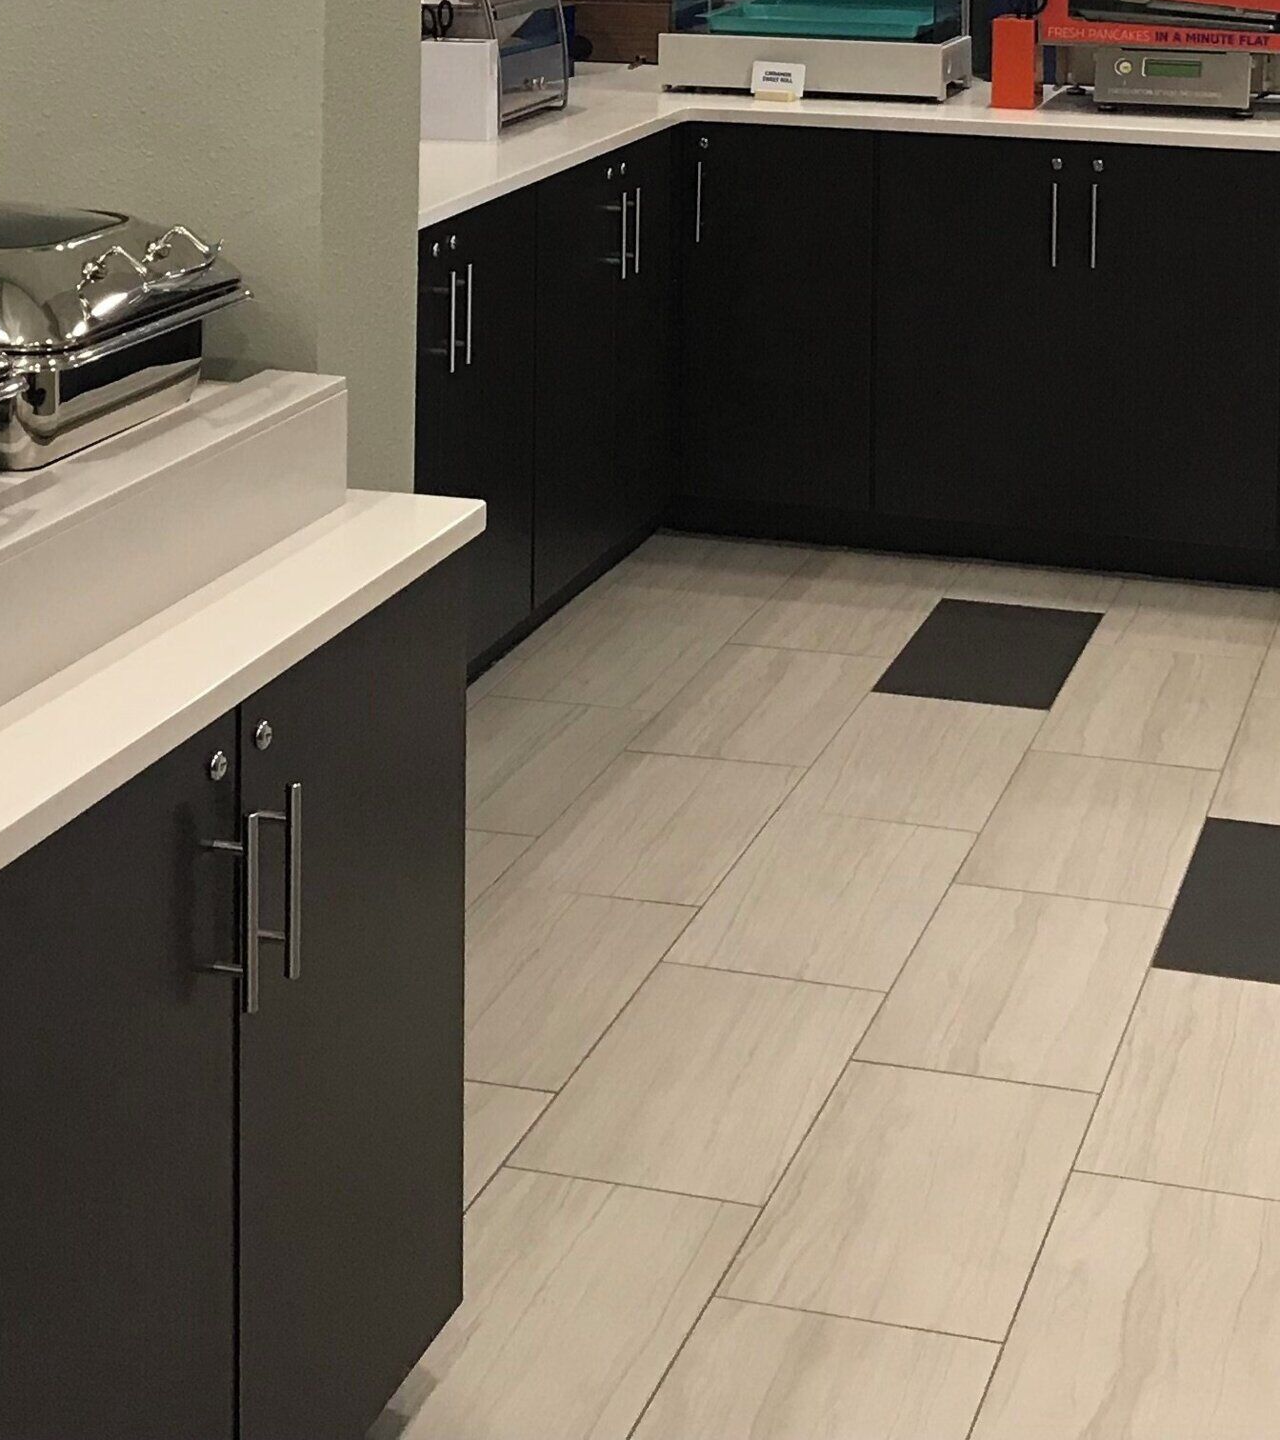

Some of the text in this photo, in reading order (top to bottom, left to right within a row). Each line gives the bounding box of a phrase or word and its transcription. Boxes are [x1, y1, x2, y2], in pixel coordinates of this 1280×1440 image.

[1047, 26, 1270, 46] FRESH PANCAKES IN A MINUTE FLAT
